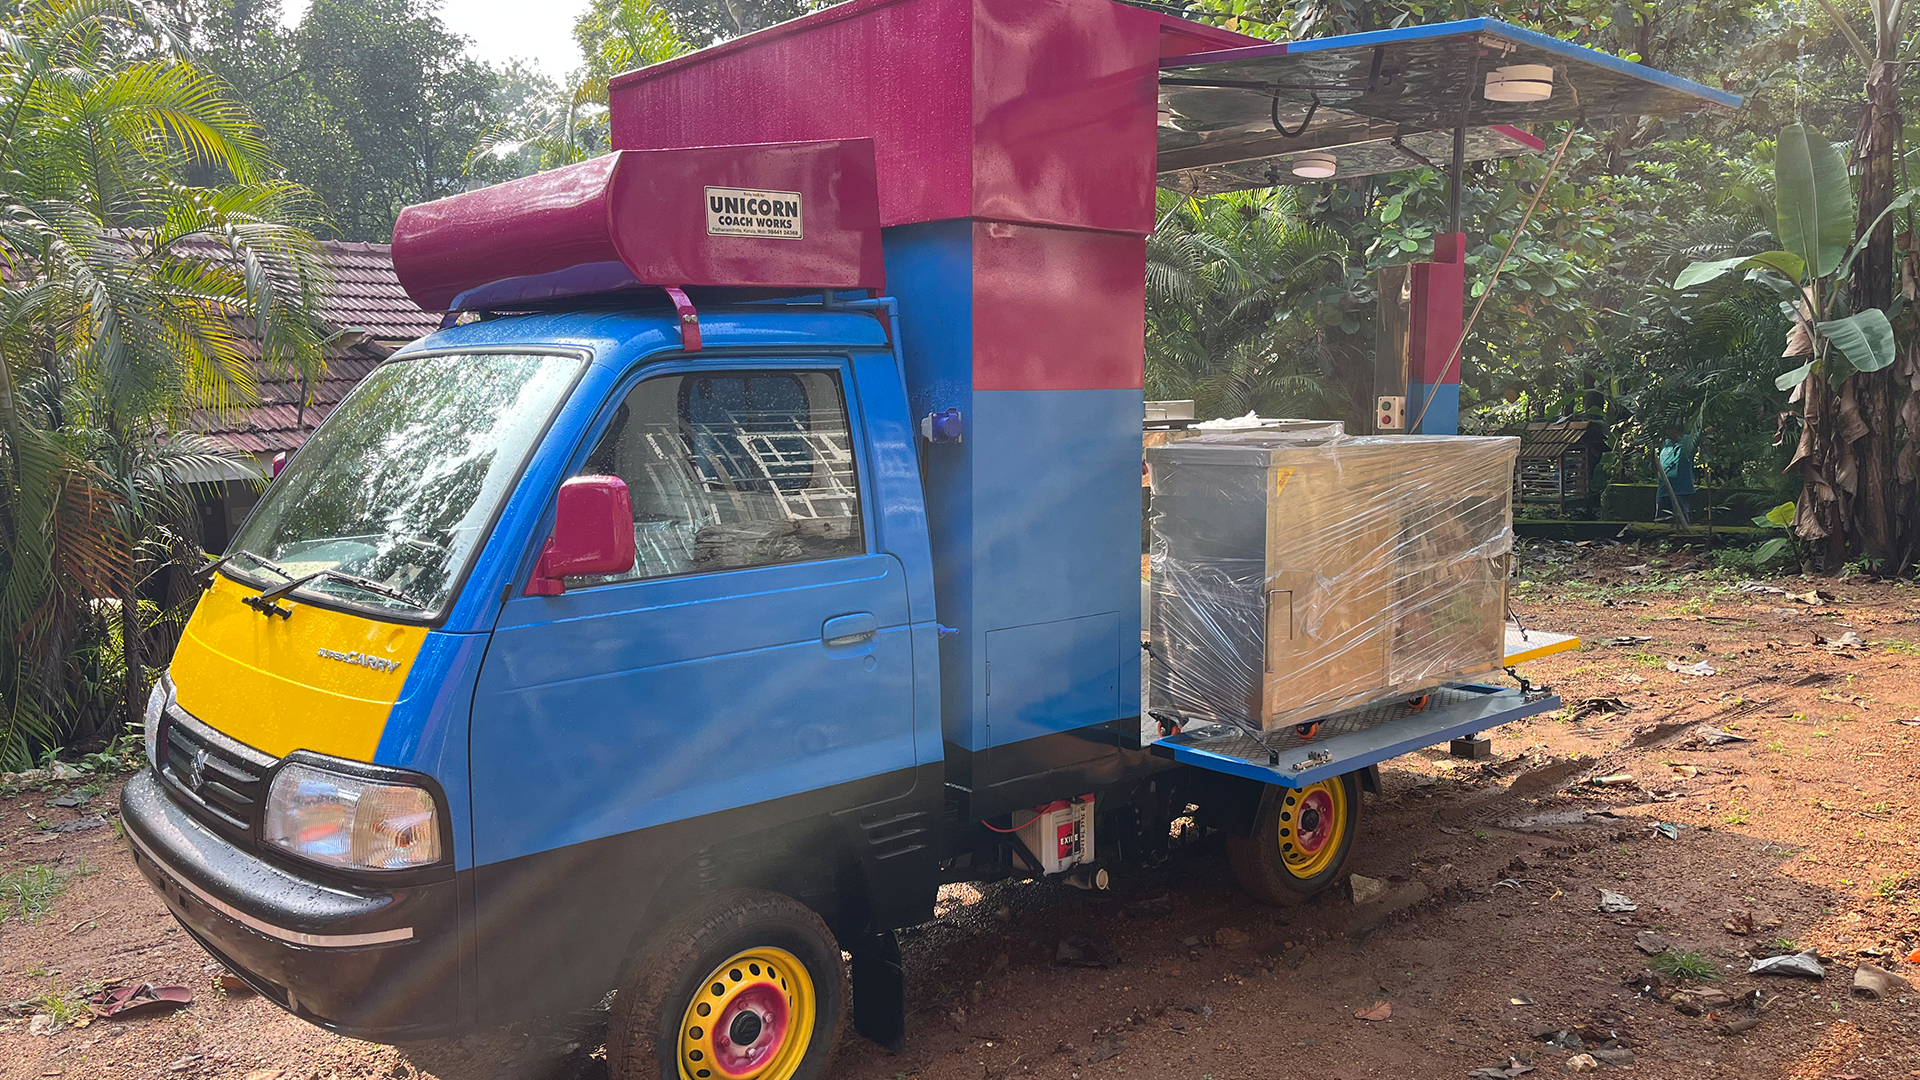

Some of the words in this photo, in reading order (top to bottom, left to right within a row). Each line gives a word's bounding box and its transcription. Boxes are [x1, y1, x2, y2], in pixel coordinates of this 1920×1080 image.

[710, 196, 798, 217] UNICORN
[718, 216, 753, 226] COACH
[756, 218, 792, 229] WORKS
